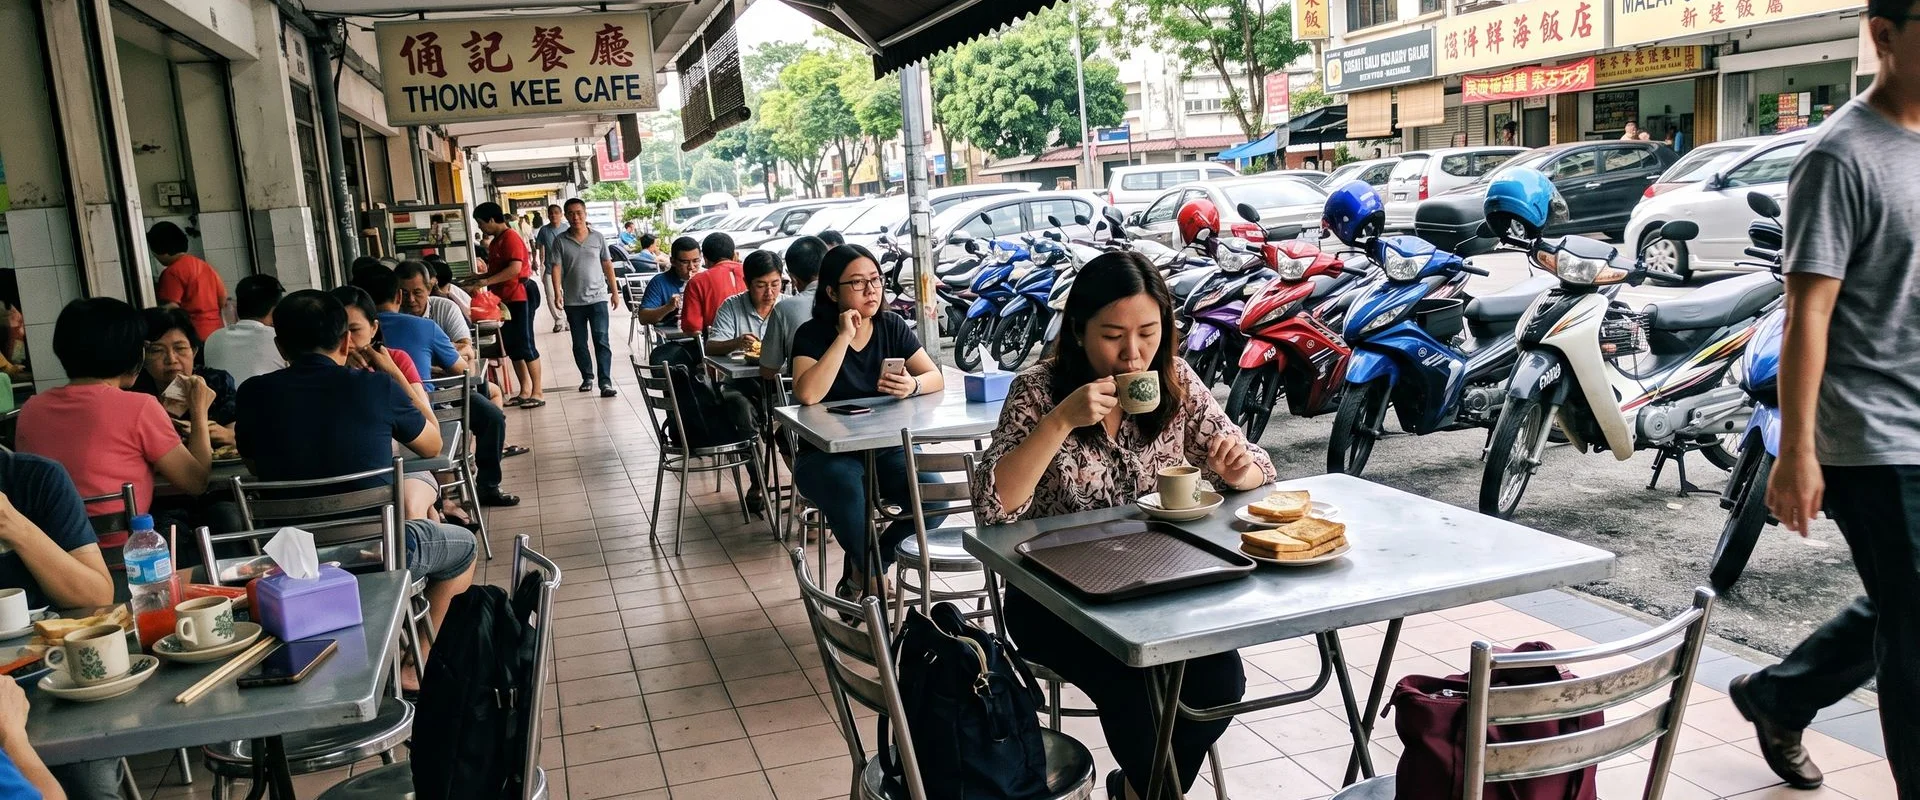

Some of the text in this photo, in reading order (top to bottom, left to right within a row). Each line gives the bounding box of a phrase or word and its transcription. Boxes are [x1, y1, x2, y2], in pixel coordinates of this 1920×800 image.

[1622, 0, 1673, 14] MAL
[402, 74, 642, 113] THONG KEE CAFE
